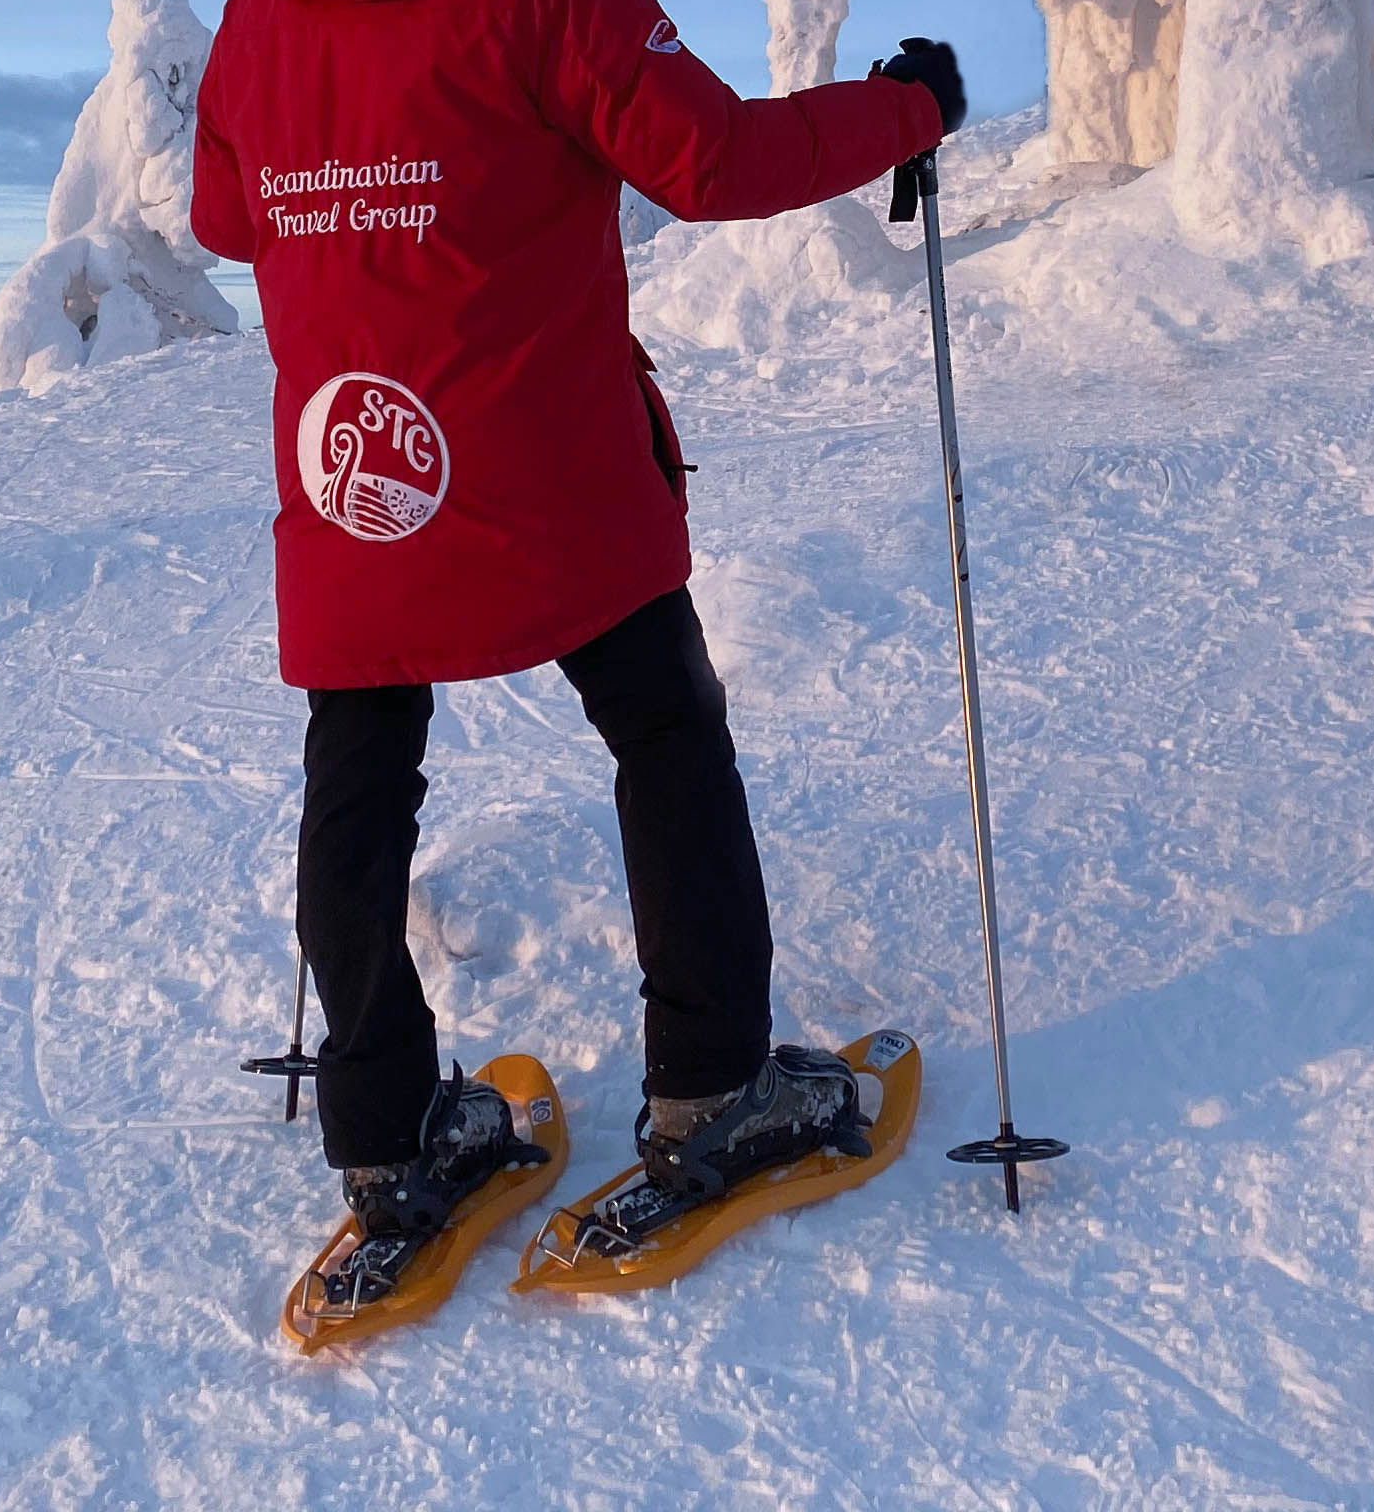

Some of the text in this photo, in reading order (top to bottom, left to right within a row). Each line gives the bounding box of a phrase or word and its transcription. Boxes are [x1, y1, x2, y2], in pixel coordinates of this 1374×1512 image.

[259, 154, 444, 199] Scandinavian
[267, 198, 438, 244] Travel Group
[358, 389, 435, 473] STG
